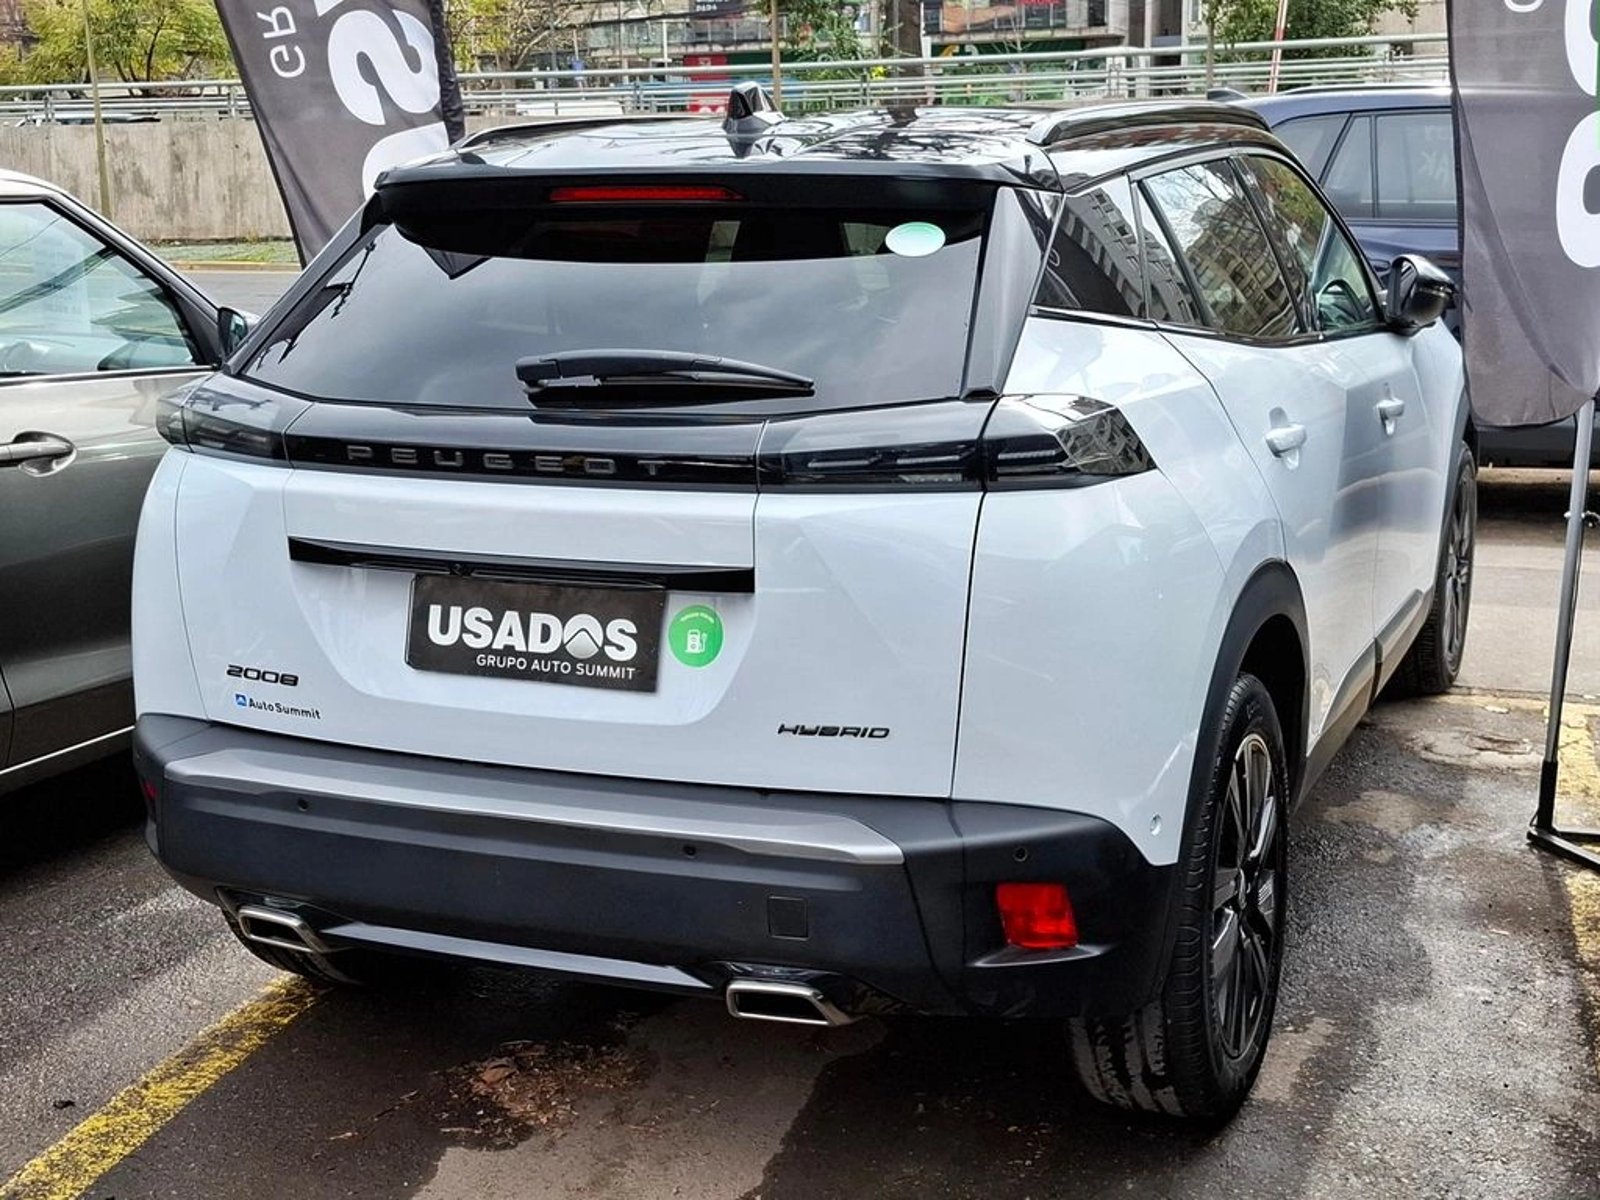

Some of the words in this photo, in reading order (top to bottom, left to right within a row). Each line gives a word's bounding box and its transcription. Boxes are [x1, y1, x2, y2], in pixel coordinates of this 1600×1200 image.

[347, 445, 666, 475] PEUGEOT
[427, 604, 638, 662] USADOS
[226, 664, 299, 687] 2008
[476, 654, 528, 669] GRUPO
[531, 660, 571, 674] AUTO
[575, 662, 636, 680] SUMMIT
[778, 724, 890, 738] HYBRID
